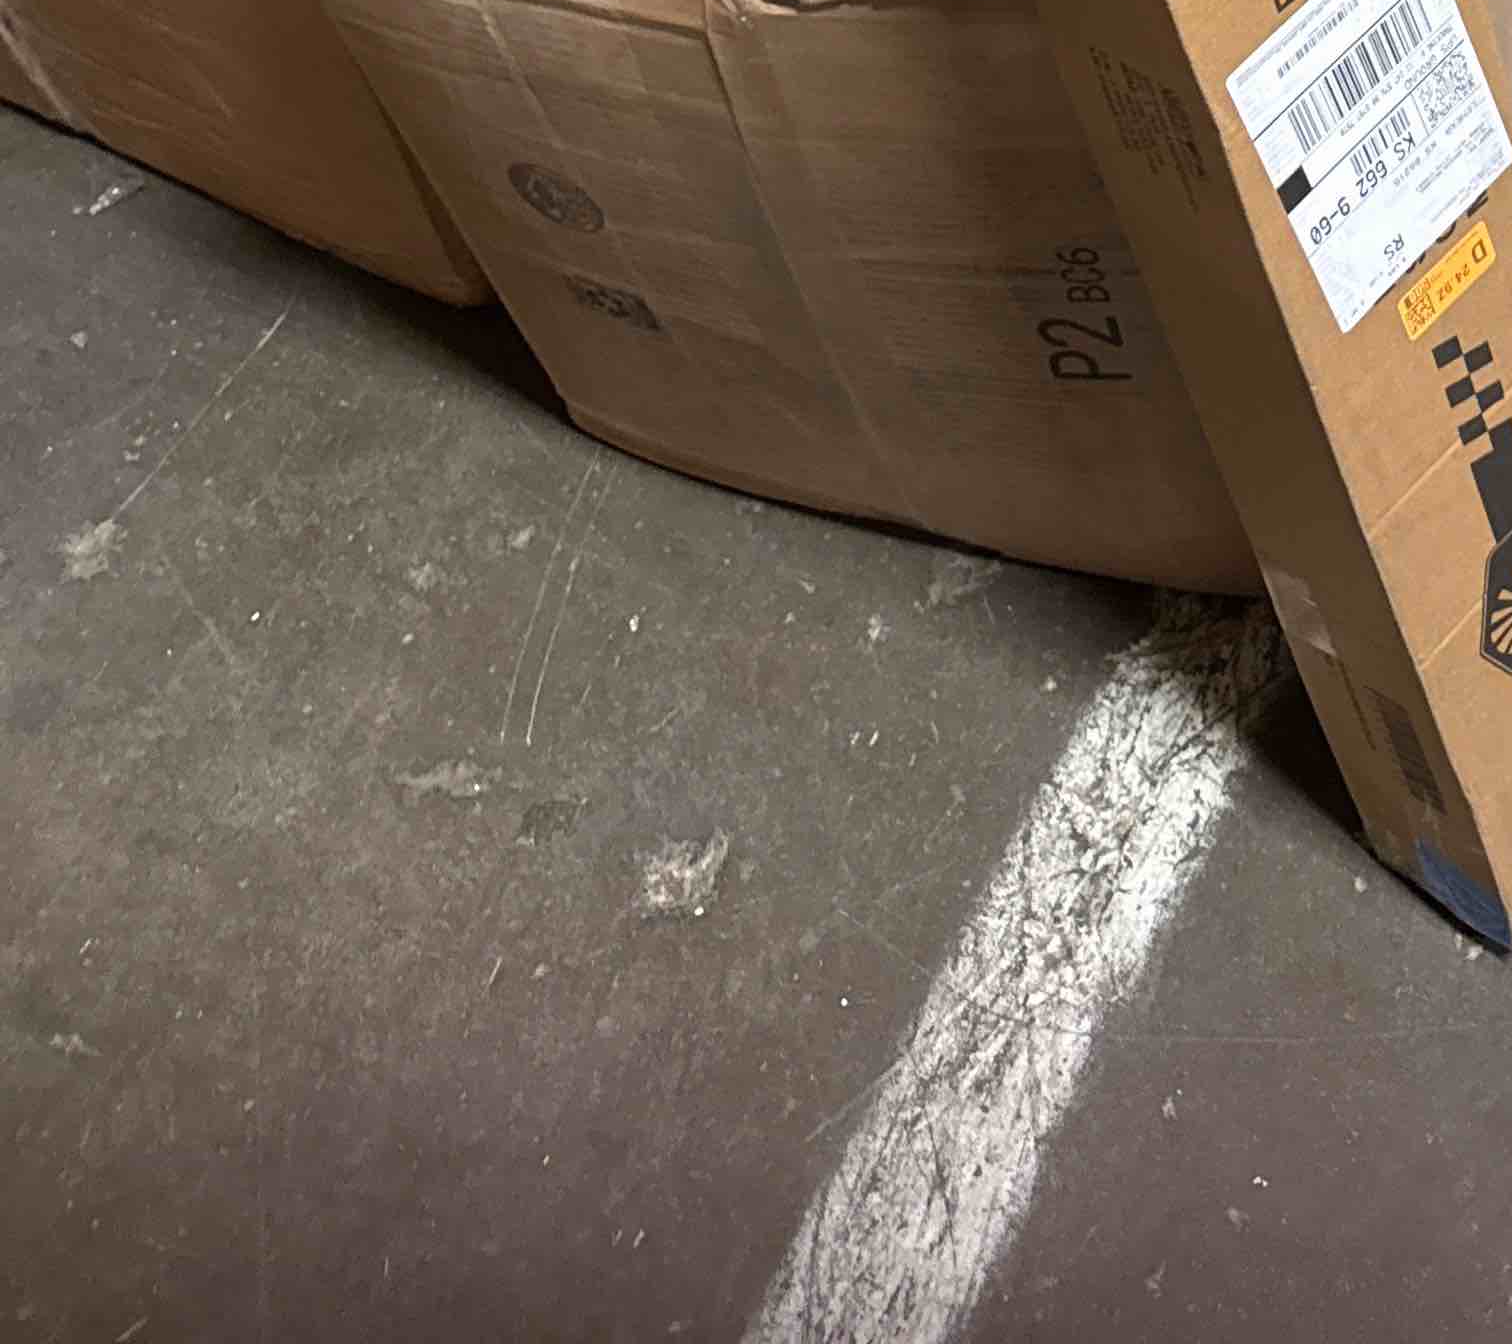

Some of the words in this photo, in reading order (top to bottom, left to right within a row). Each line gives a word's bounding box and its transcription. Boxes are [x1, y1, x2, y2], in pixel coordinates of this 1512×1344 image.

[1391, 130, 1415, 161] KS
[1354, 158, 1388, 198] 662
[1307, 195, 1351, 245] 9-60
[1382, 232, 1404, 260] RS
[1470, 238, 1487, 264] D
[1065, 245, 1112, 305] BC6
[1036, 313, 1134, 384] P2
